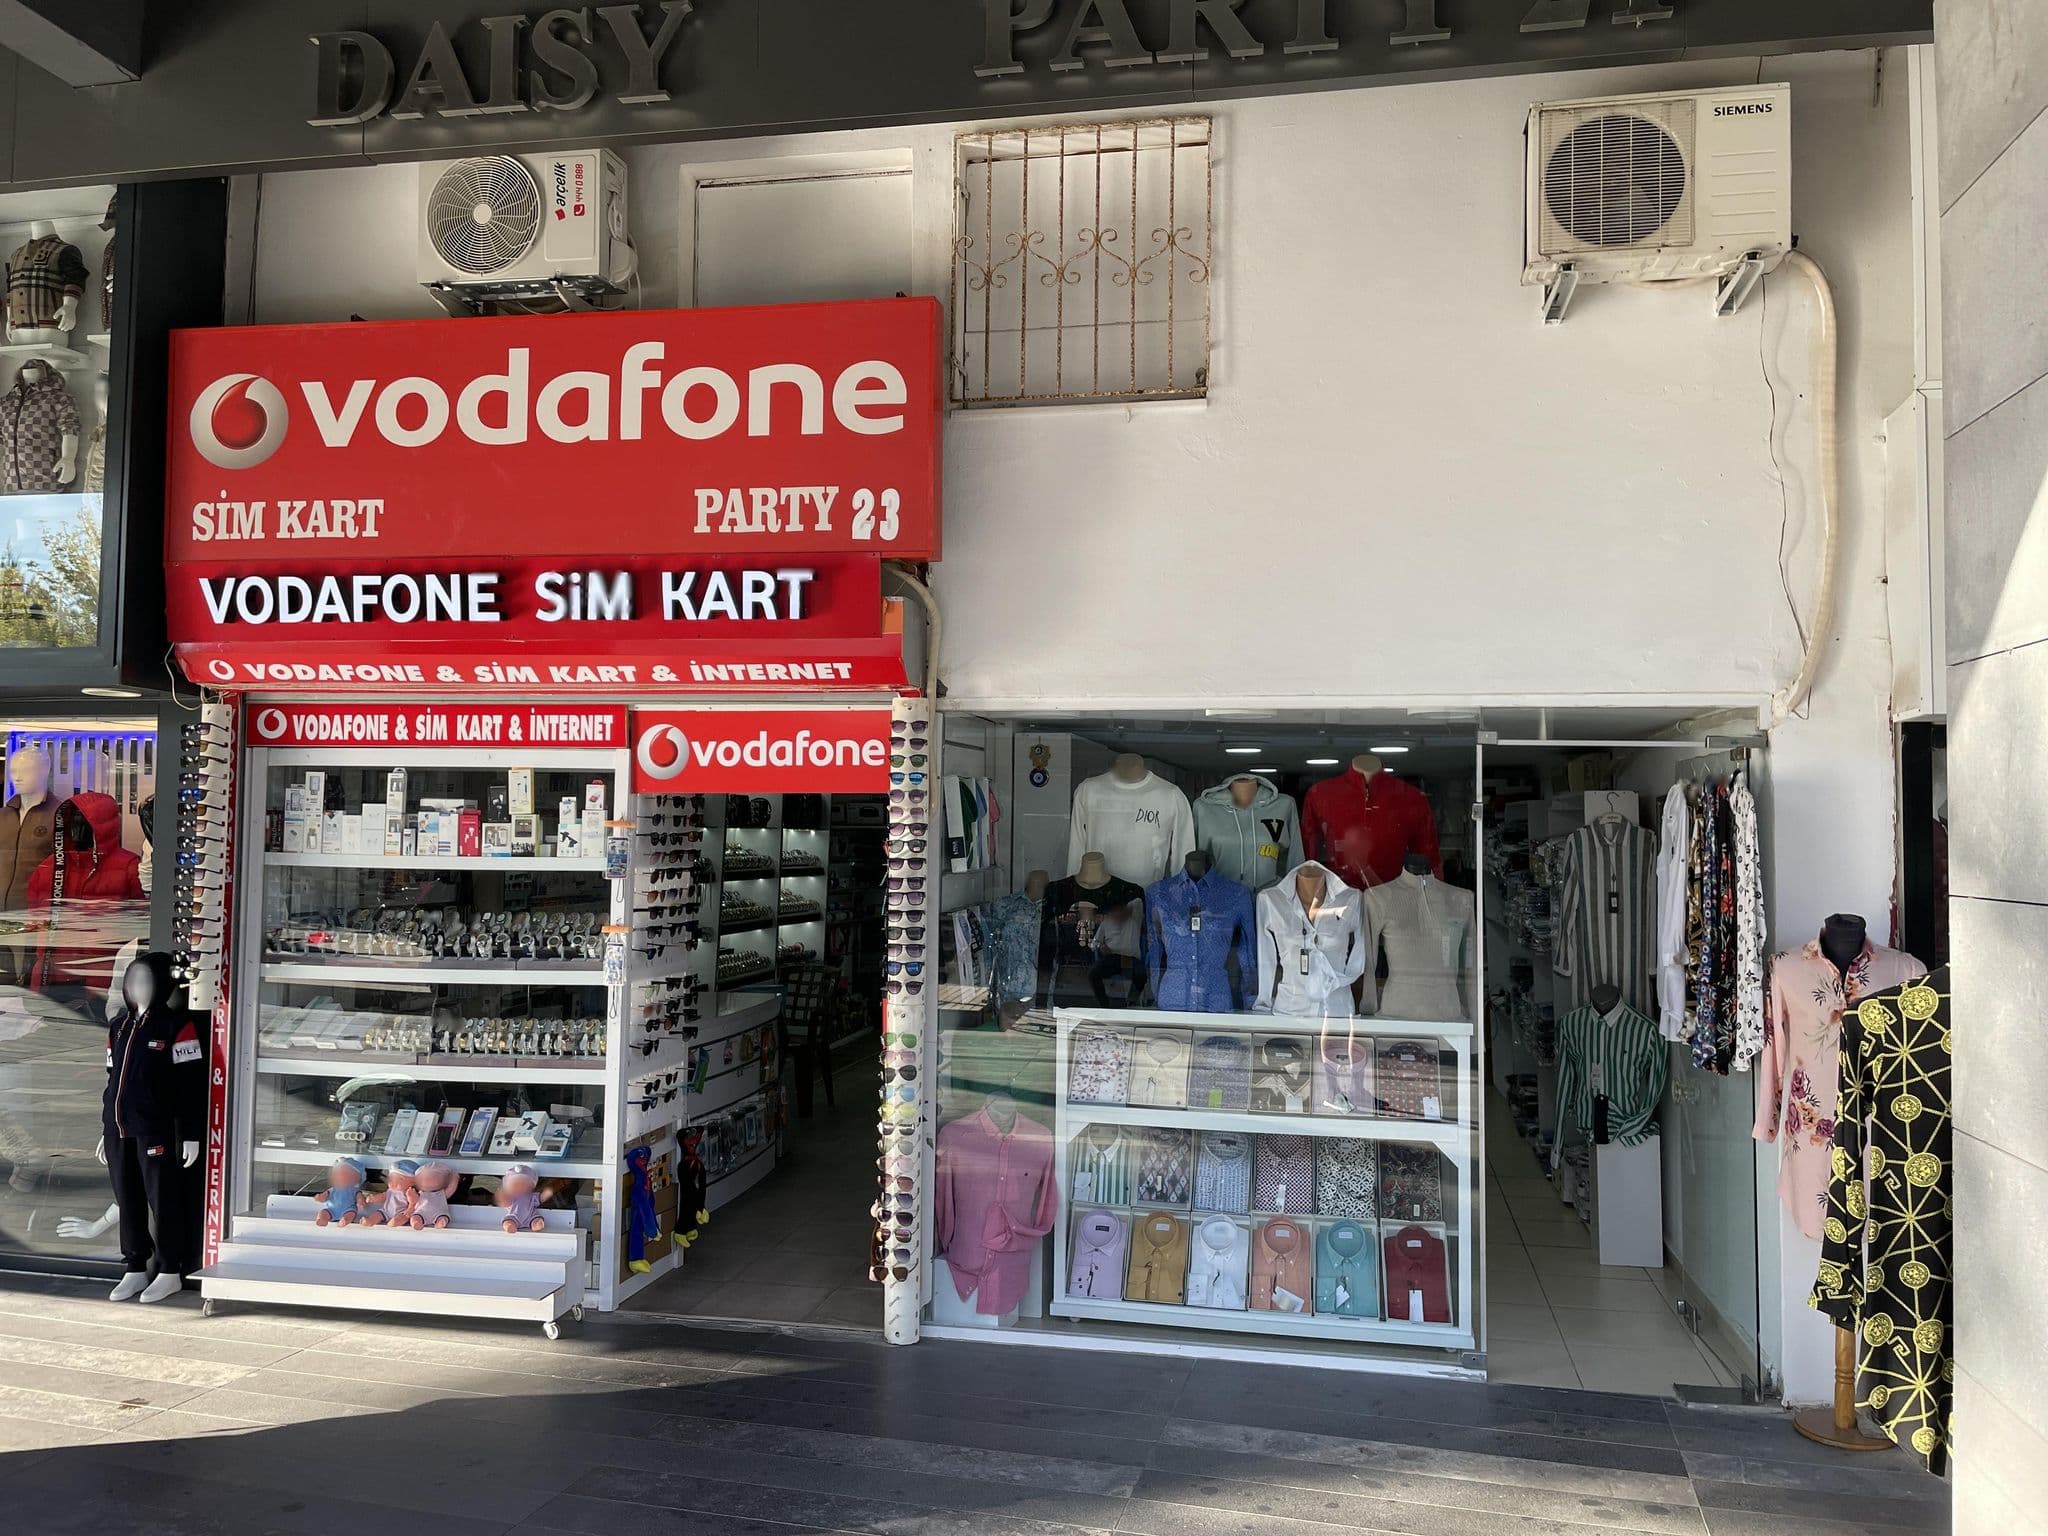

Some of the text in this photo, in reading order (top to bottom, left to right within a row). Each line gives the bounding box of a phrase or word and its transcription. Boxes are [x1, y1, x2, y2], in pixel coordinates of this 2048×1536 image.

[305, 0, 693, 126] DAISY
[1714, 103, 1772, 116] SIEMENS
[554, 162, 568, 206] arçelik
[300, 342, 907, 448] vodafone
[192, 486, 901, 542] SİM KART PARTY 23
[198, 574, 501, 625] VODAFONE
[662, 569, 814, 621] KART
[243, 660, 852, 683] VODAFONE & SİM KART & İNTERNET
[292, 707, 613, 742] VODAFONE & SİM KART & İNTERNET
[691, 730, 886, 767] vodafone
[1135, 808, 1160, 828] DIOR
[1260, 819, 1285, 843] V
[54, 831, 64, 865] MONCLER
[53, 870, 64, 905] MONCLER
[213, 1068, 224, 1086] &
